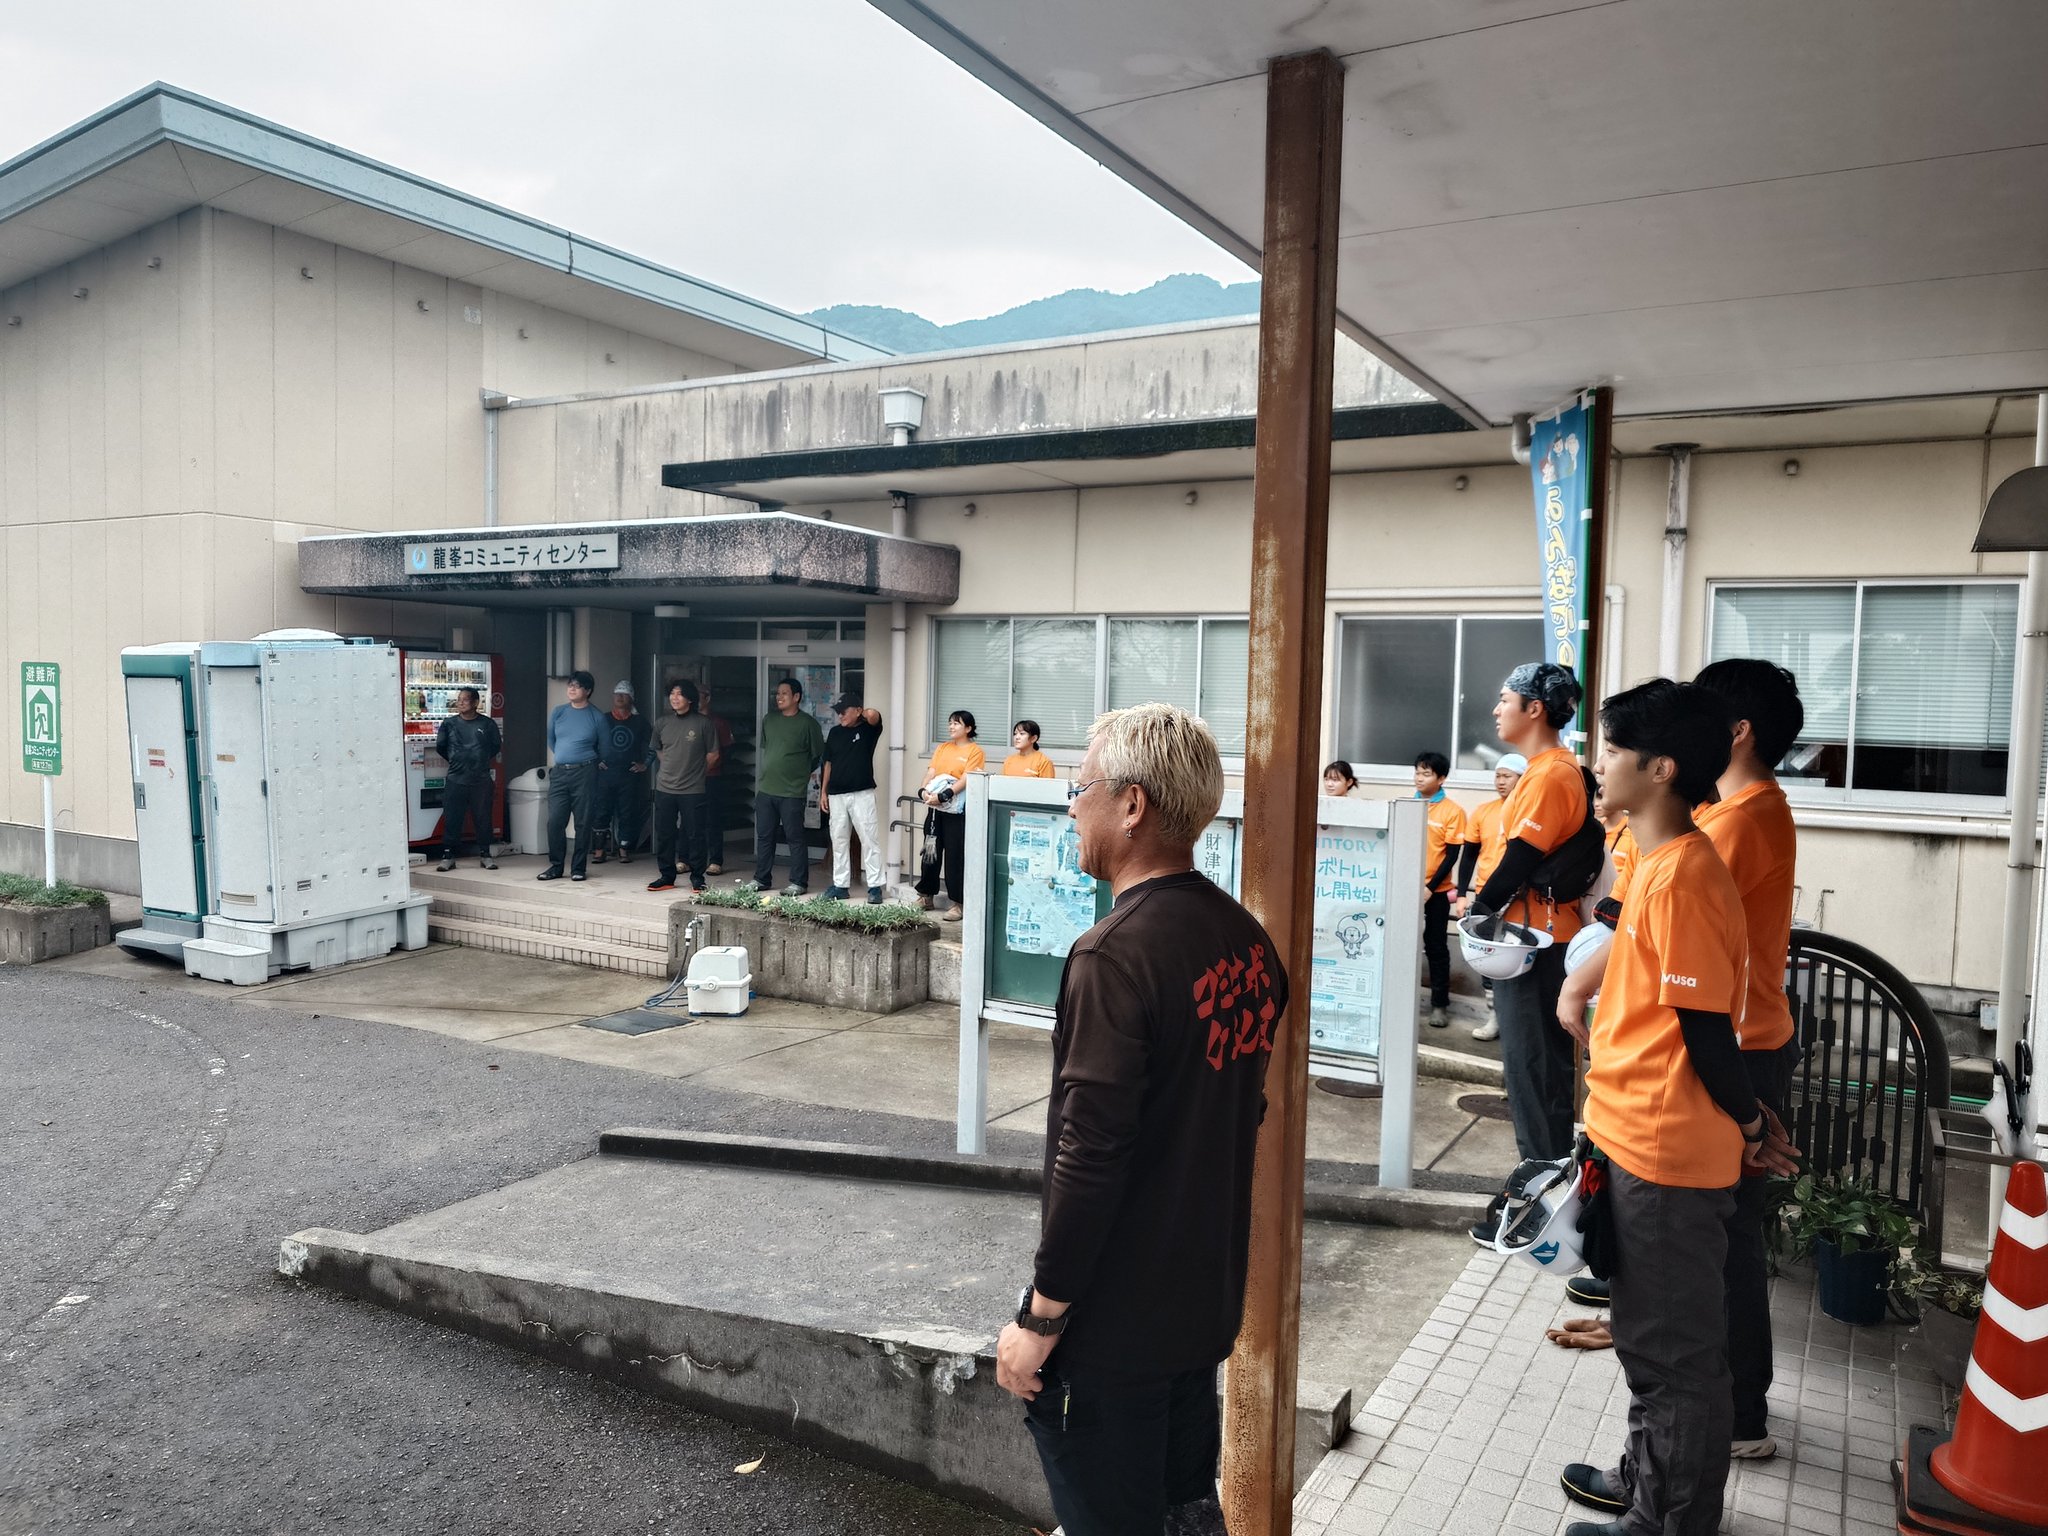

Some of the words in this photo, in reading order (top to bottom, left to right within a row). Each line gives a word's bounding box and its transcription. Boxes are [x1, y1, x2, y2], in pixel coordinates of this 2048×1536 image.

[433, 541, 607, 569] 龍峯コミュニティセンター
[25, 665, 56, 683] 避難所
